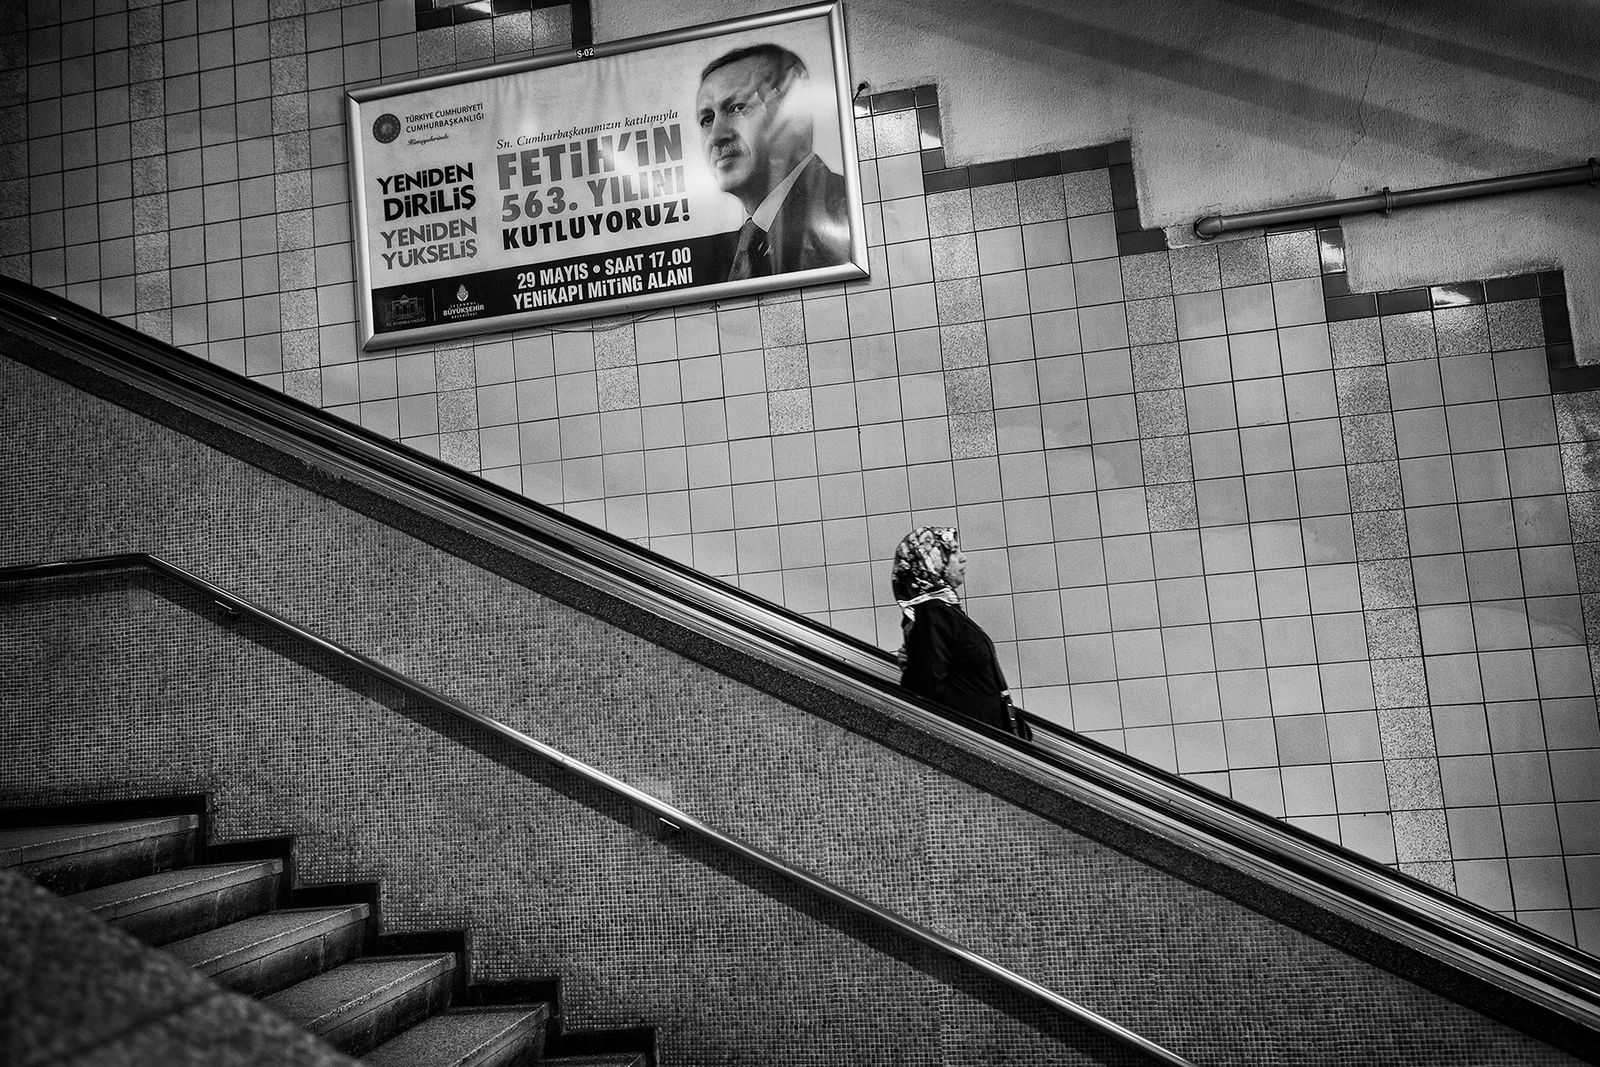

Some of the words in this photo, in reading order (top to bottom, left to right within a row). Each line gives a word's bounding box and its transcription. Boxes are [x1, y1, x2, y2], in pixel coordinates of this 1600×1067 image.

[577, 48, 594, 59] S-02
[405, 112, 434, 124] TÜRKİYE
[435, 102, 483, 118] CUMHURİYETİ
[405, 113, 484, 133] CUMHURBAŞKANLIĞI
[496, 138, 513, 150] Sn.
[517, 121, 621, 146] Cumhurbaşkanımızın
[624, 109, 678, 128] katılımıyla
[502, 187, 578, 222] 563.
[587, 165, 686, 207] YILINI
[502, 198, 690, 250] KUTLUYORUZ!
[517, 271, 536, 289] 29
[539, 263, 589, 286] MAYIS
[604, 254, 644, 276] SAAT
[648, 247, 692, 269] 17.00
[647, 266, 693, 290] ALANI
